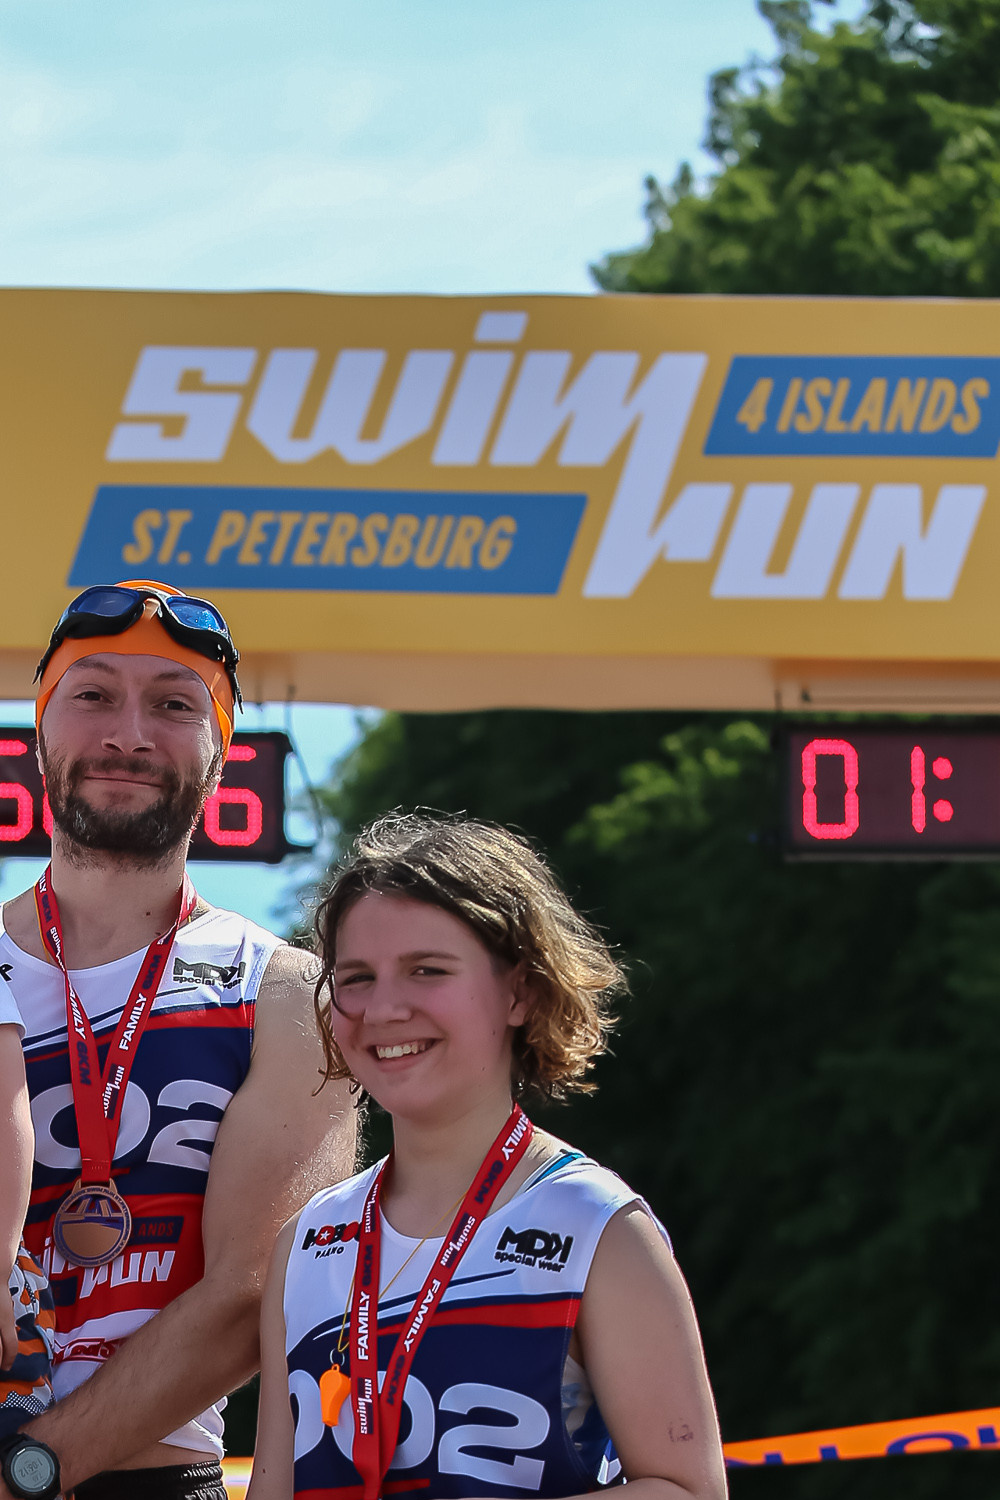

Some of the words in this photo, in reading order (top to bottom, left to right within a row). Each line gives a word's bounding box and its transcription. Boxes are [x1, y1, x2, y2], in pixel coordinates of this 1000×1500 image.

[737, 378, 766, 434] 4
[776, 376, 990, 435] ISLANDS
[122, 508, 193, 565] ST.
[205, 509, 518, 570] PETERSBURG
[118, 992, 148, 1051] FAMILY
[494, 1251, 536, 1267] special
[538, 1257, 566, 1274] wear
[357, 1290, 371, 1361] FAMILY
[402, 1278, 441, 1353] FAMILY
